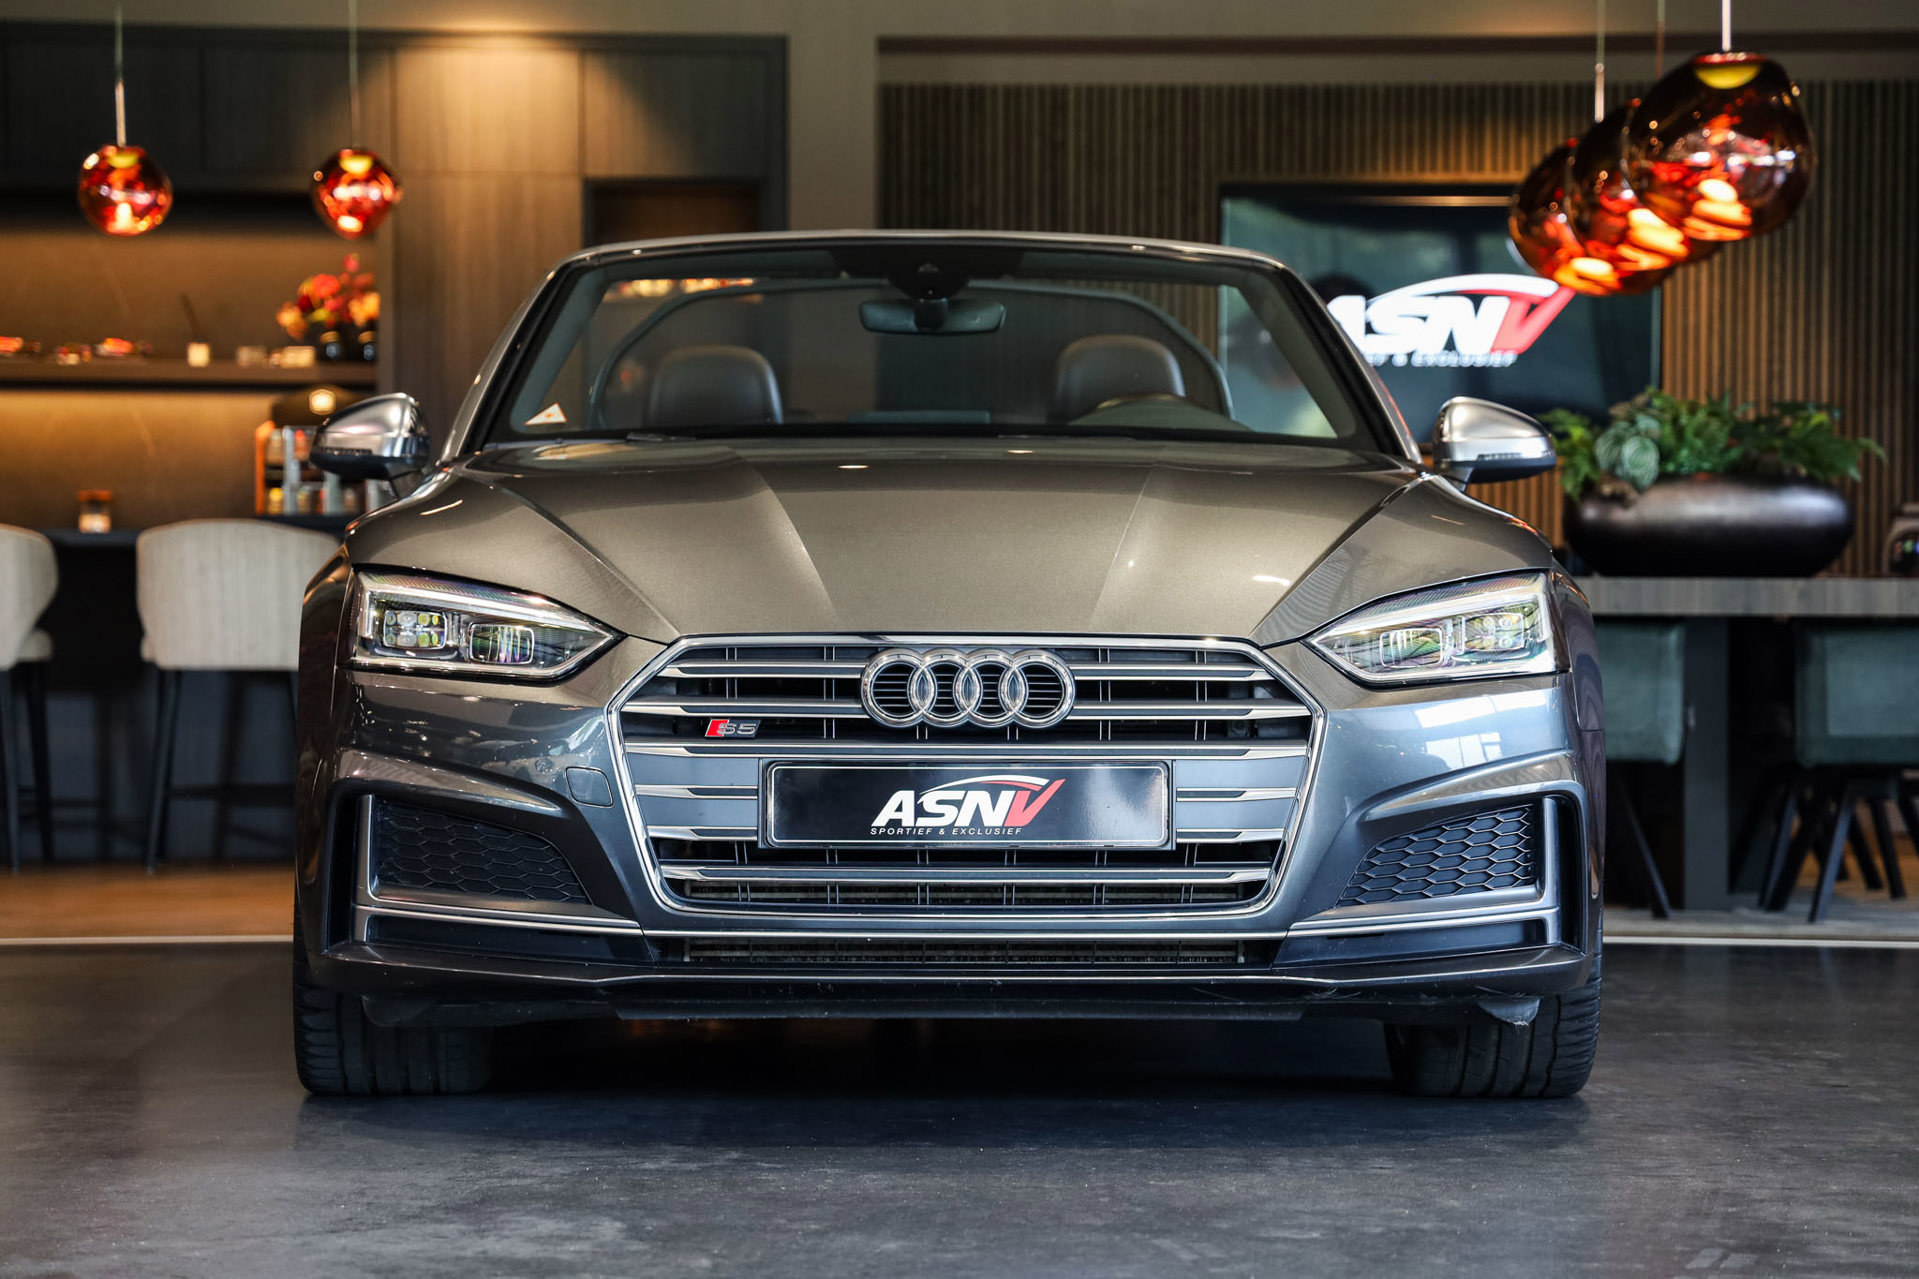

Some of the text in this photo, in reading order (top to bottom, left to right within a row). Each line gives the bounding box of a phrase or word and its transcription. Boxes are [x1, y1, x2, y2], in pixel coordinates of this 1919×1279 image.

[716, 722, 757, 736] S5
[871, 778, 1066, 827] ASNV
[870, 828, 1022, 836] SPORTIEF & EXCLUSIEF
